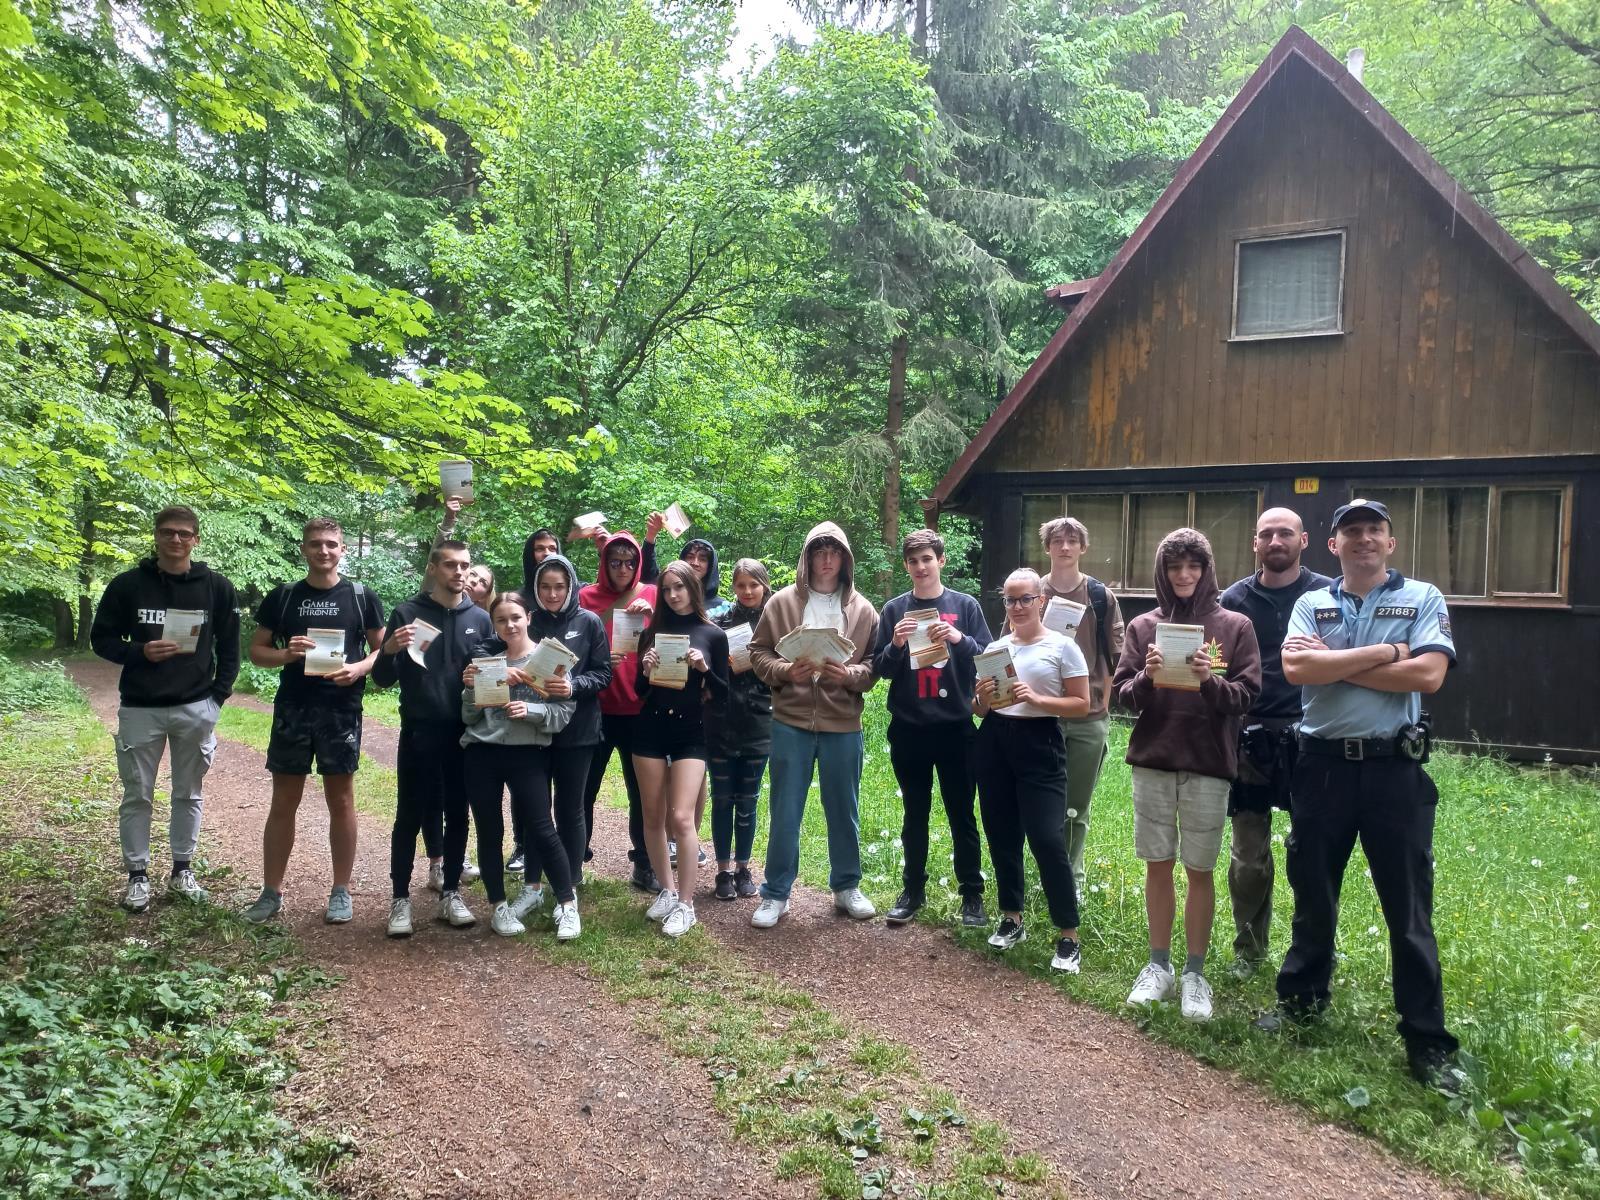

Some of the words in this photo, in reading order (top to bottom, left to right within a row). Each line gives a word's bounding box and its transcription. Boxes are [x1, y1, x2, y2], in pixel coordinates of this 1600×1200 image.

[302, 599, 329, 609] GAME
[298, 607, 340, 617] THRONES
[1377, 607, 1416, 617] 271687
